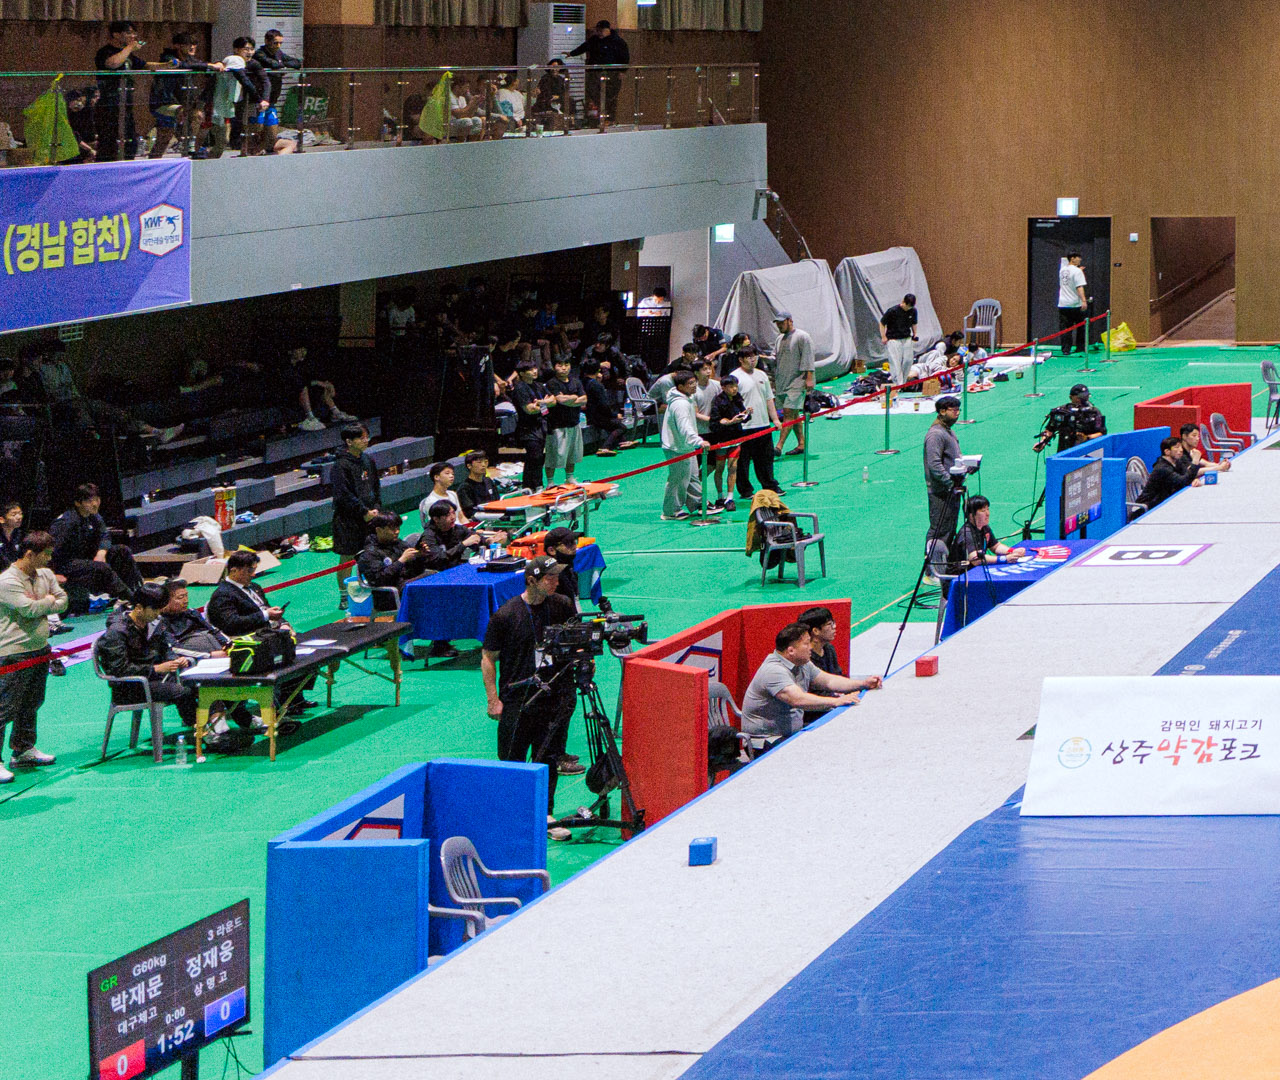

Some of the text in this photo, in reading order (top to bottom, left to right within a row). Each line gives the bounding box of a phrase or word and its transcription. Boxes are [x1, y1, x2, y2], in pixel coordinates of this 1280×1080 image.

[144, 216, 163, 229] KWF
[3, 213, 132, 275] (경남 합천)
[1160, 719, 1263, 732] 감먹인 돼지고기
[207, 916, 243, 941] 3 라운드
[132, 954, 167, 977] G60kg
[186, 939, 234, 978] 정재웅
[100, 974, 118, 992] GR
[111, 974, 164, 1013] 박재문
[165, 1006, 186, 1025] 0:00
[220, 1001, 230, 1020] 0
[157, 1019, 195, 1054] 1:52
[117, 1055, 128, 1076] 0
